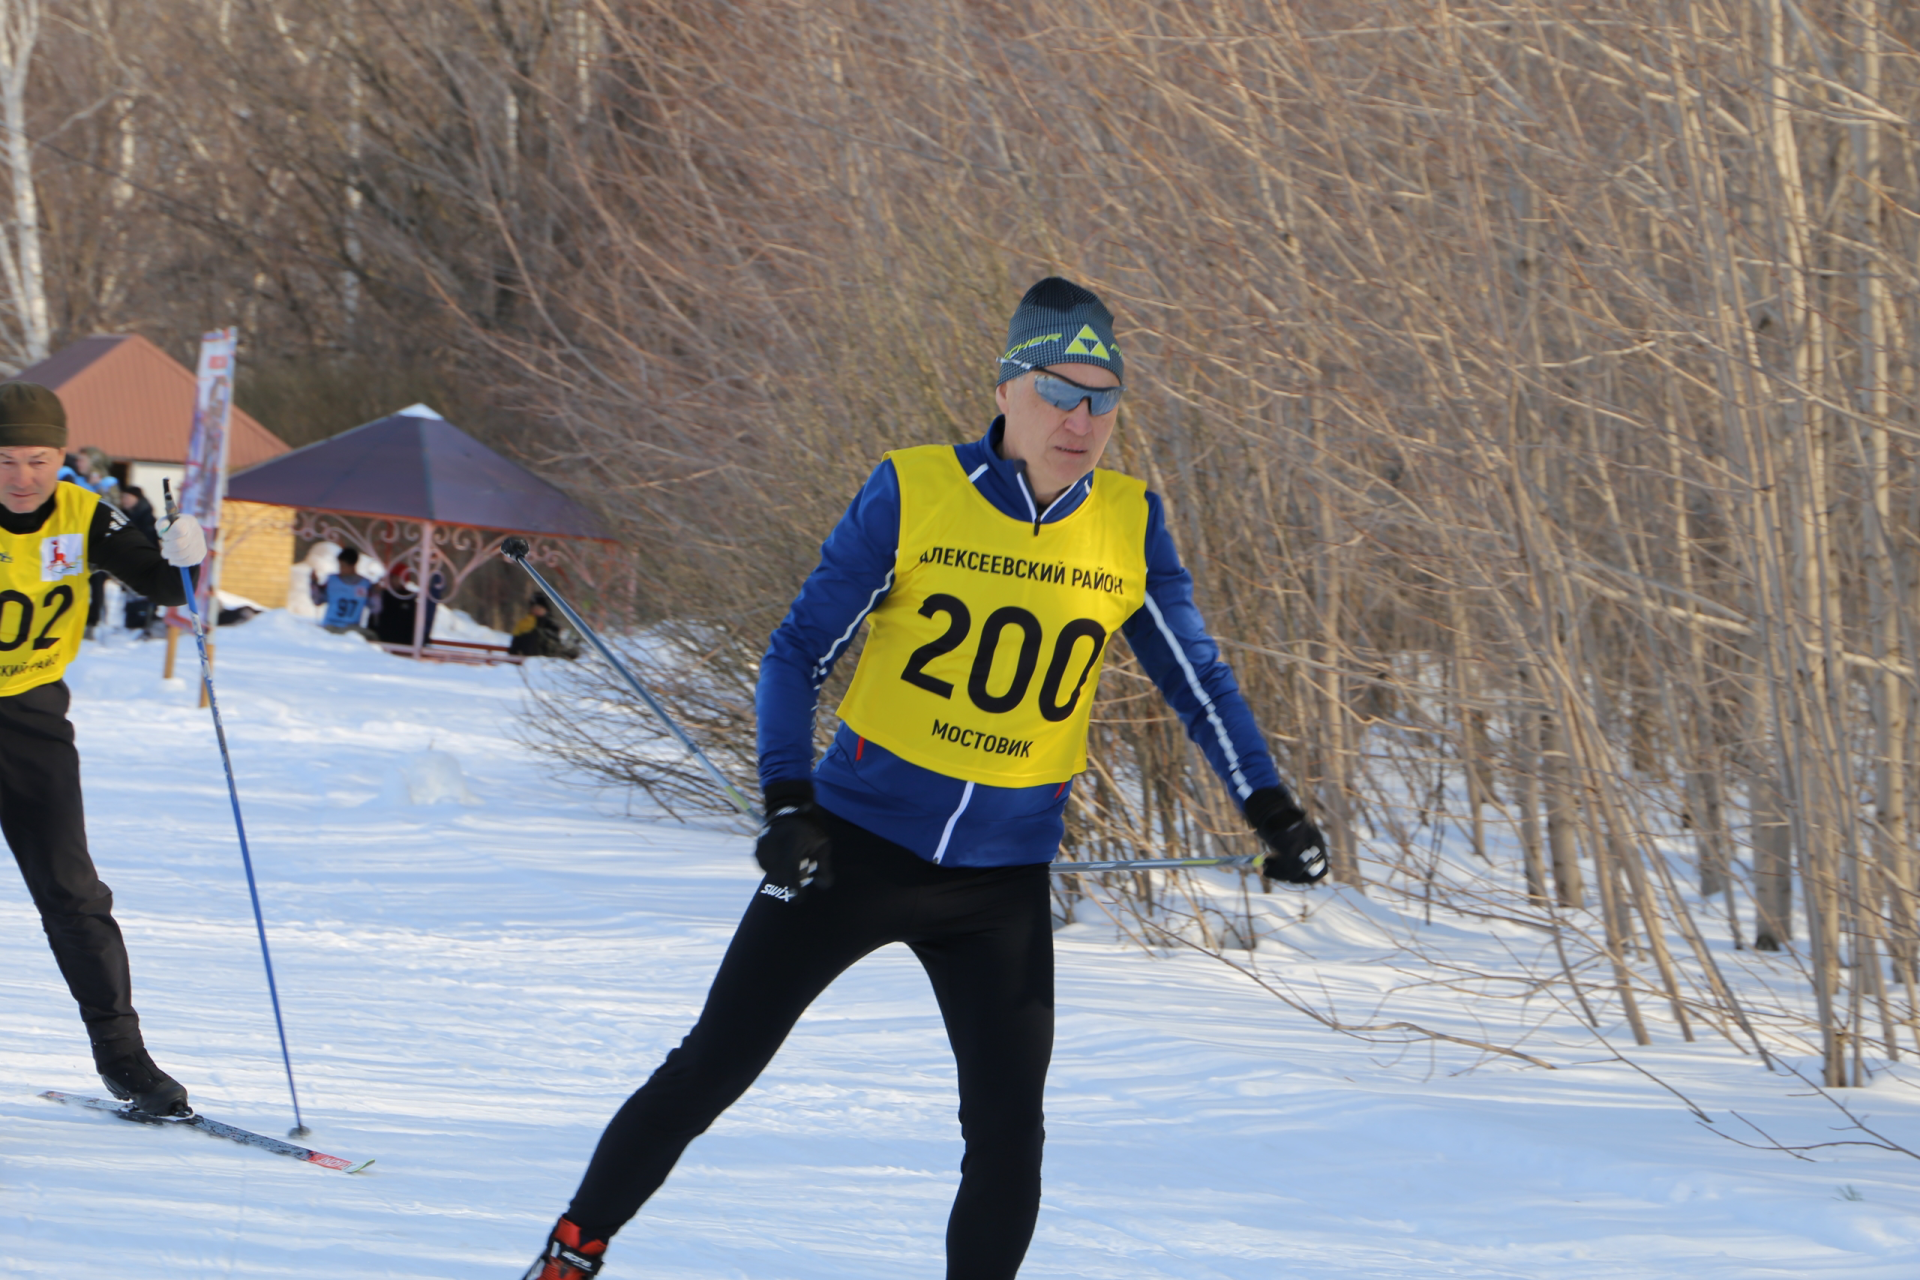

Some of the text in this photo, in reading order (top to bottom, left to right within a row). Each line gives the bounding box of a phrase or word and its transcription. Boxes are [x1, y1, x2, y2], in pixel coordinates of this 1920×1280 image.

[1071, 567, 1124, 595] РАЙОН
[900, 593, 1107, 722] 200
[931, 719, 1034, 758] МОСТОВИК
